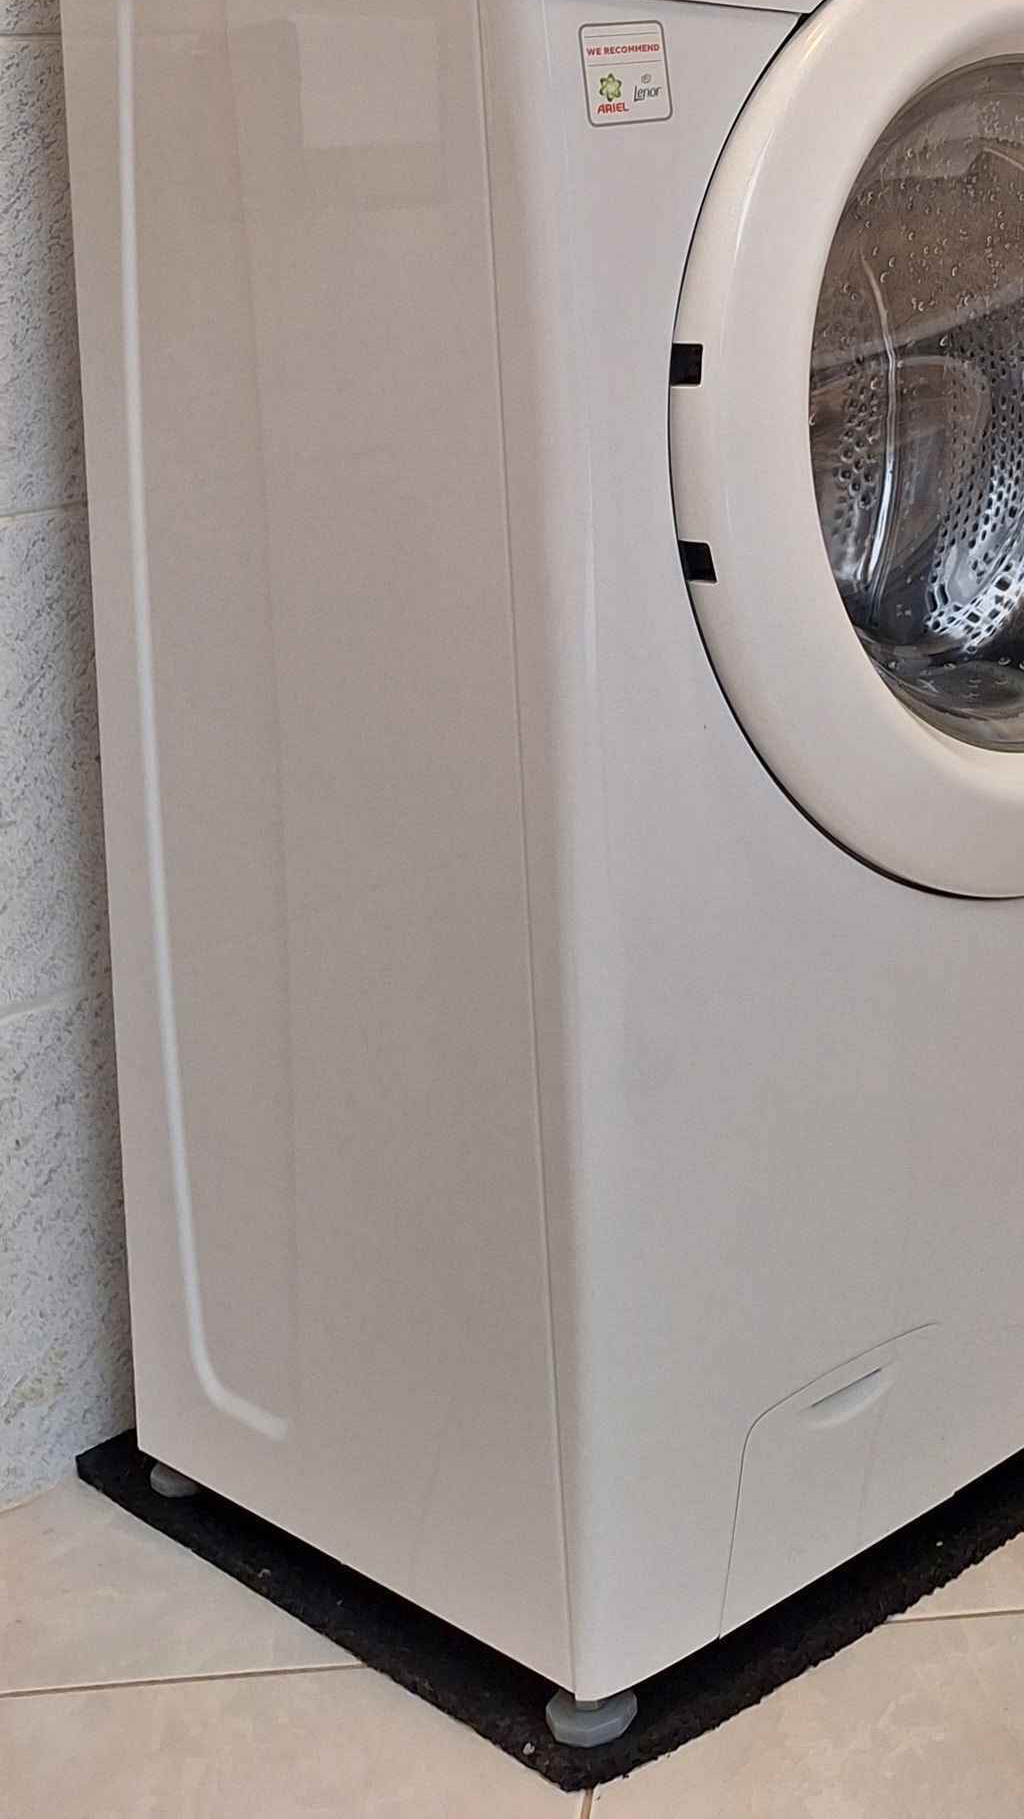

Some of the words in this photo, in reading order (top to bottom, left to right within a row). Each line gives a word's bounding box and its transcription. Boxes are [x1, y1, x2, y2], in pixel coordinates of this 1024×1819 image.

[586, 47, 602, 56] WE
[604, 43, 660, 55] RECOMMEND
[633, 85, 662, 102] Lenor
[597, 102, 630, 114] ARIEL
